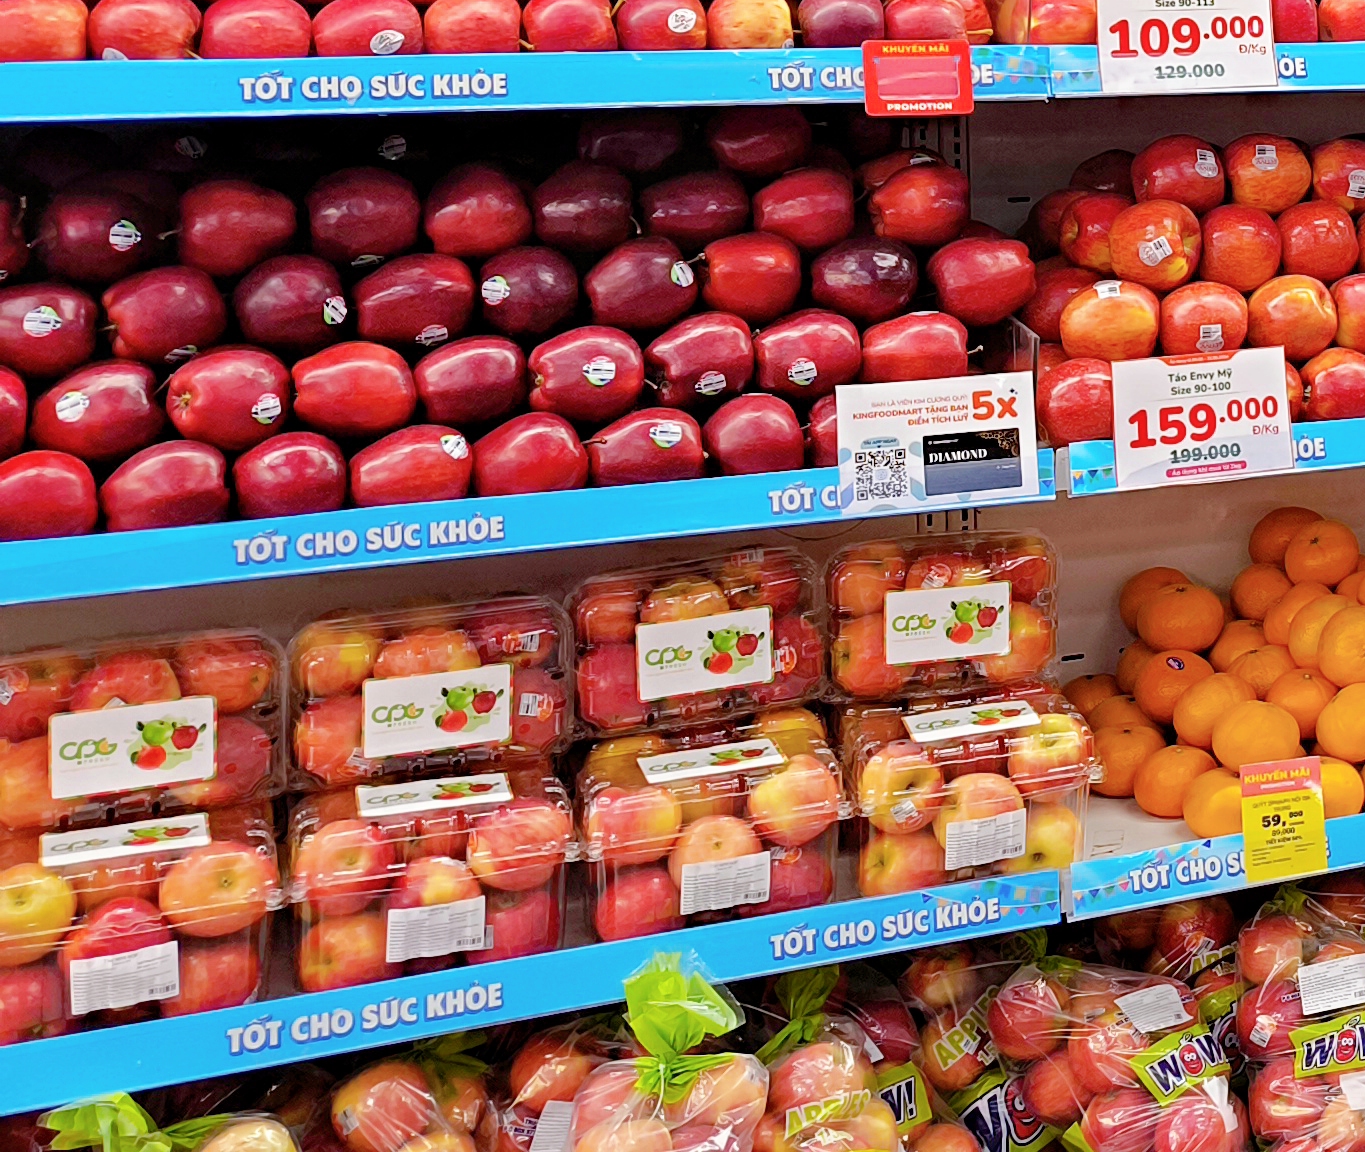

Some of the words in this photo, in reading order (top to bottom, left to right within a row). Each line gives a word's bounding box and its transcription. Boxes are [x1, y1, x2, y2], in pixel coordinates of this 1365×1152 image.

[1155, 0, 1176, 8] Size
[1109, 15, 1264, 58] 109.000
[1155, 64, 1225, 79] 129.000
[239, 68, 294, 102] TỐT
[301, 74, 363, 101] CHO
[370, 70, 425, 100] SỨC
[432, 67, 507, 97] KHỎE
[886, 101, 953, 112] PROMOTION
[1168, 372, 1187, 383] Táo
[1190, 371, 1214, 383] Envy
[1218, 368, 1232, 379] Mỹ
[1171, 386, 1191, 396] Size
[1194, 382, 1231, 393] 90-100
[853, 407, 924, 420] KINGFOODMART
[925, 404, 949, 417] TẶNG
[951, 404, 968, 414] BẠN
[972, 390, 1018, 421] 5x
[1128, 396, 1278, 449] 159.000
[1253, 425, 1279, 435] Đ/Kg
[929, 448, 988, 463] DIAMOND
[1170, 443, 1241, 464] 199.000
[232, 530, 290, 566] TỐT
[296, 527, 358, 559] CHO
[366, 520, 423, 554] SỨC
[428, 510, 506, 548] KHỎE
[1244, 769, 1288, 784] KHUYẾN
[1290, 767, 1310, 778] MÃI
[1128, 861, 1171, 893] TỐT
[1176, 855, 1222, 885] CHO
[770, 923, 820, 959] TỐT
[823, 921, 878, 948] CHO
[881, 905, 930, 938] SỨC
[934, 895, 1001, 931] KHỎE
[226, 1013, 281, 1054] TỐT
[290, 1004, 354, 1044] CHO
[360, 994, 420, 1033] SỨC
[424, 980, 504, 1022] KHỎE
